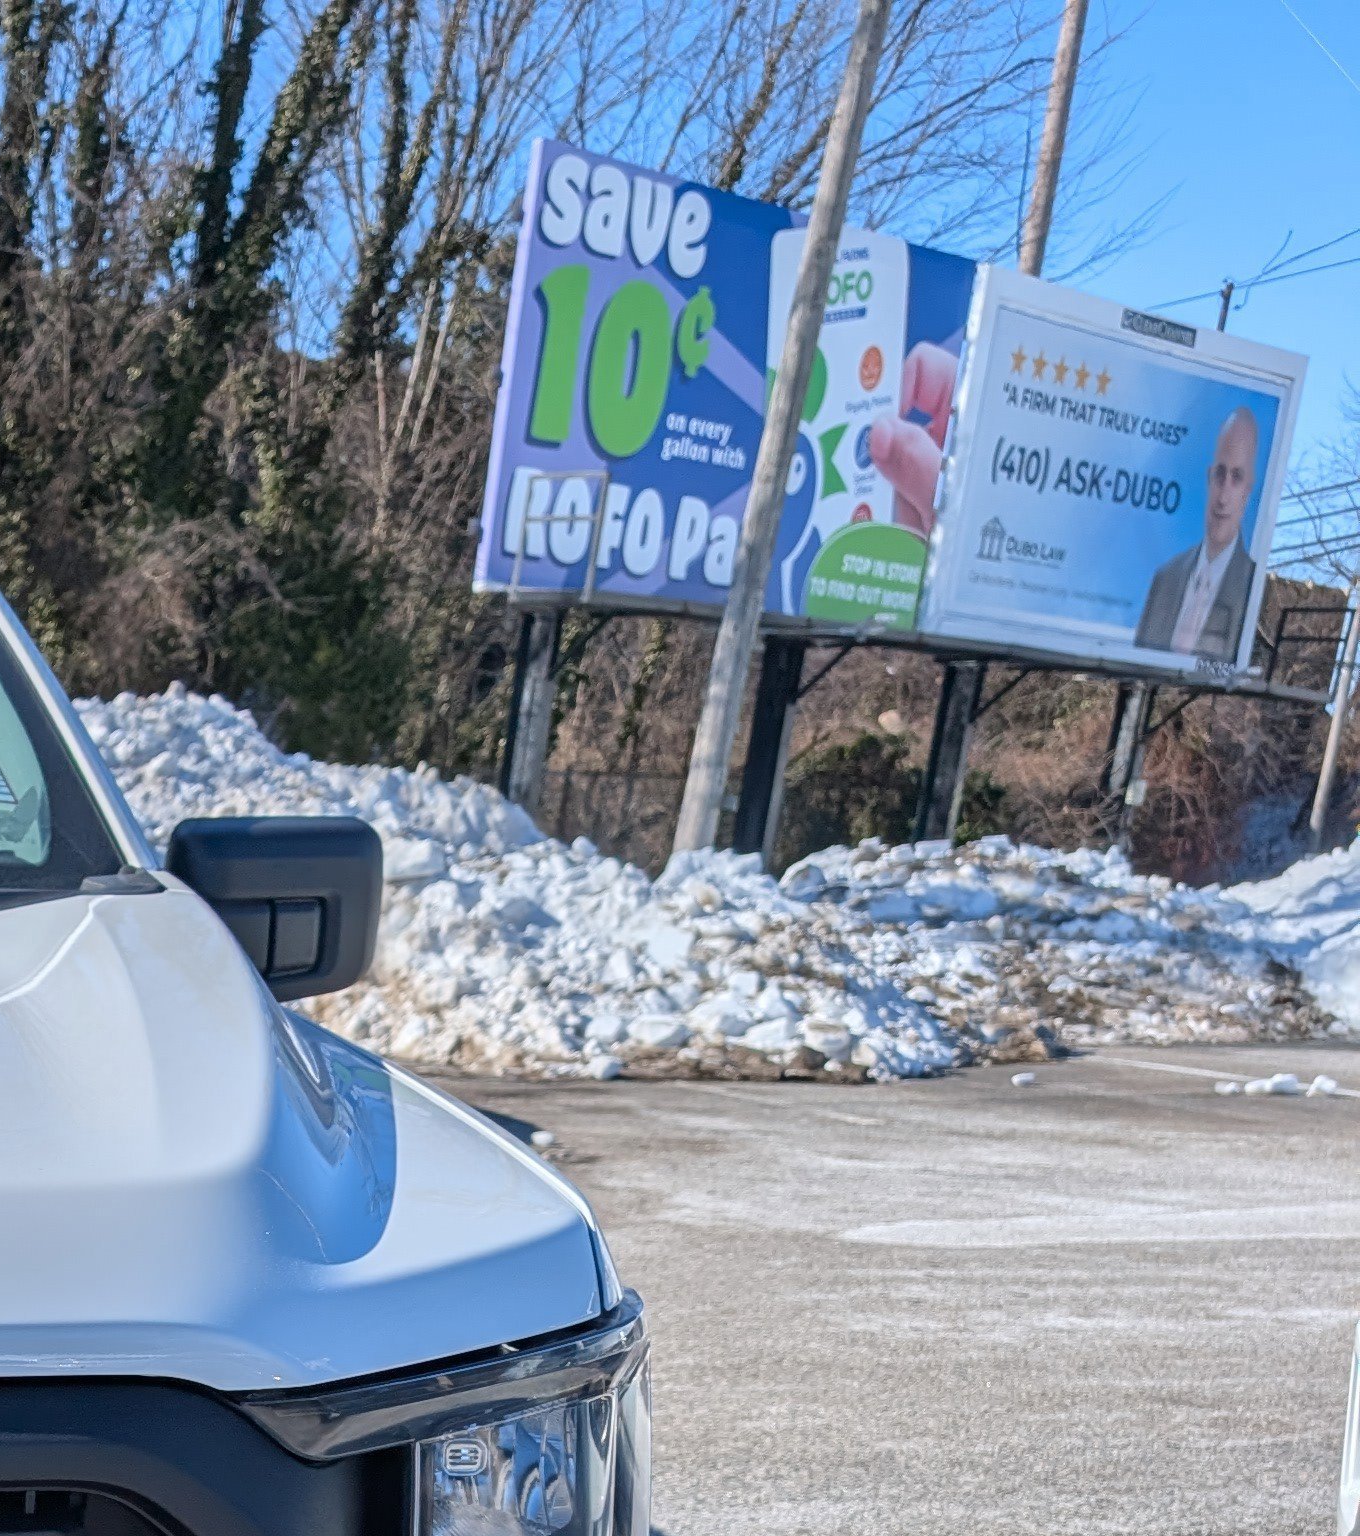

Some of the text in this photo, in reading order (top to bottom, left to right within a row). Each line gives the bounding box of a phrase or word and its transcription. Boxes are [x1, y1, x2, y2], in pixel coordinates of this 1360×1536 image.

[827, 270, 873, 305] OFO
[666, 413, 733, 447] on every
[1021, 388, 1057, 417] FIRM
[1059, 396, 1096, 425] THAT
[1098, 405, 1140, 435] TRULY
[660, 437, 746, 471] gallon with
[991, 435, 1181, 515] (410) ASK-DUBO
[668, 495, 738, 587] Pa
